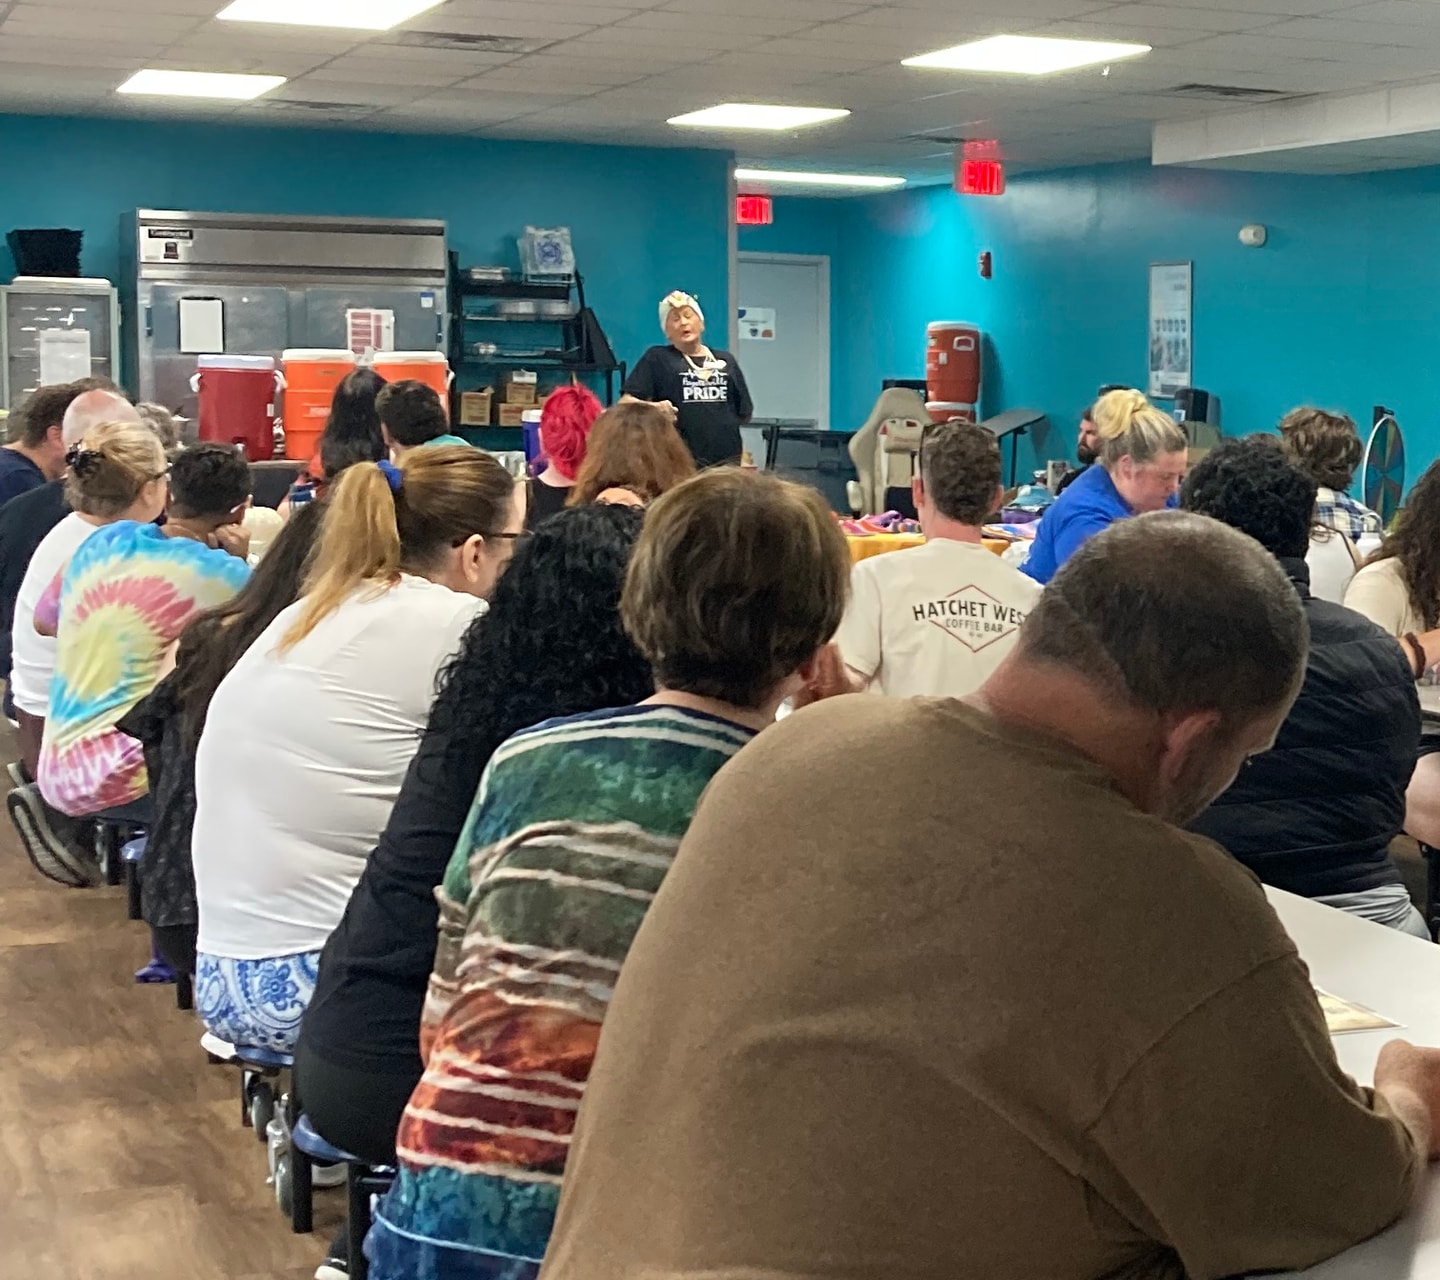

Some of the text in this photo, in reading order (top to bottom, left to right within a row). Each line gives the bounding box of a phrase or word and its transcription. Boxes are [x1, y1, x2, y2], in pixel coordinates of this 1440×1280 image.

[963, 160, 1001, 194] EXIT
[737, 197, 769, 223] EXIT
[683, 386, 728, 400] PRIDE
[912, 599, 1026, 626] HATCHET WES
[984, 622, 1003, 633] BAR
